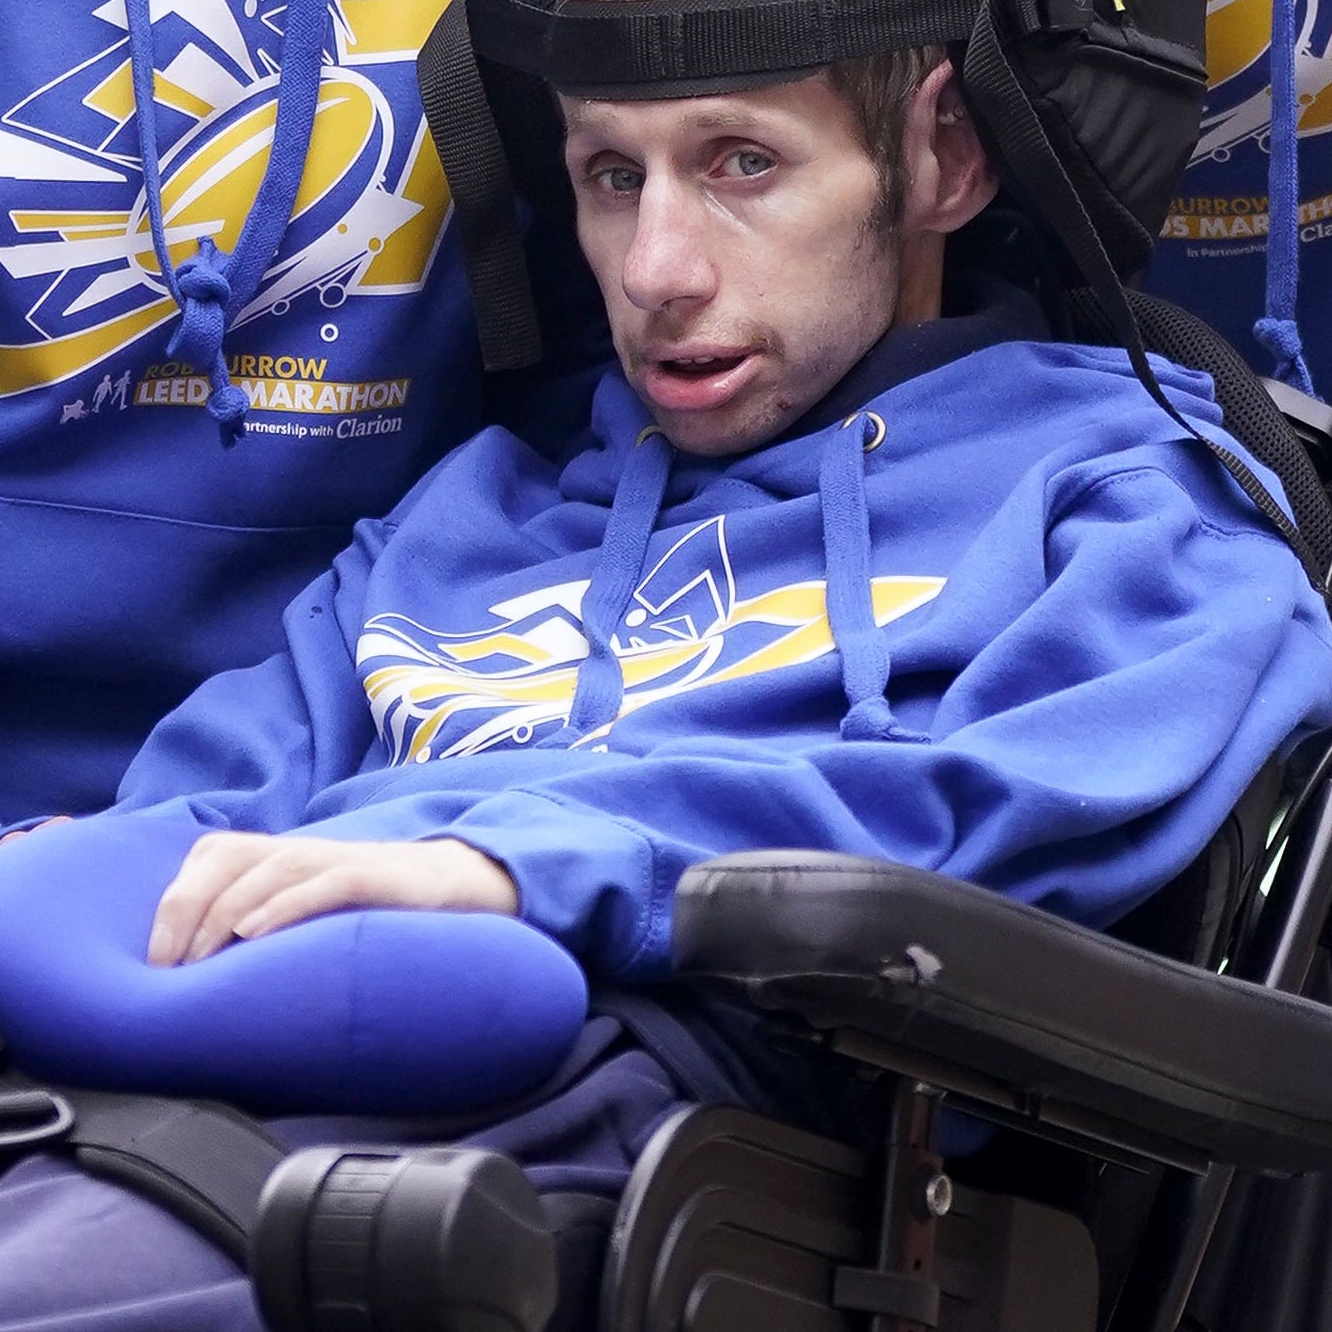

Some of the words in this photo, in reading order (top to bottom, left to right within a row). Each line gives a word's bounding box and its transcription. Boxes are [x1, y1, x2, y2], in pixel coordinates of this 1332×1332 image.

[229, 355, 328, 380] URROW
[139, 378, 212, 404] LEED
[241, 379, 411, 411] MARATHON
[244, 421, 308, 439] artnership
[310, 425, 334, 437] with
[336, 414, 403, 439] Clarion
